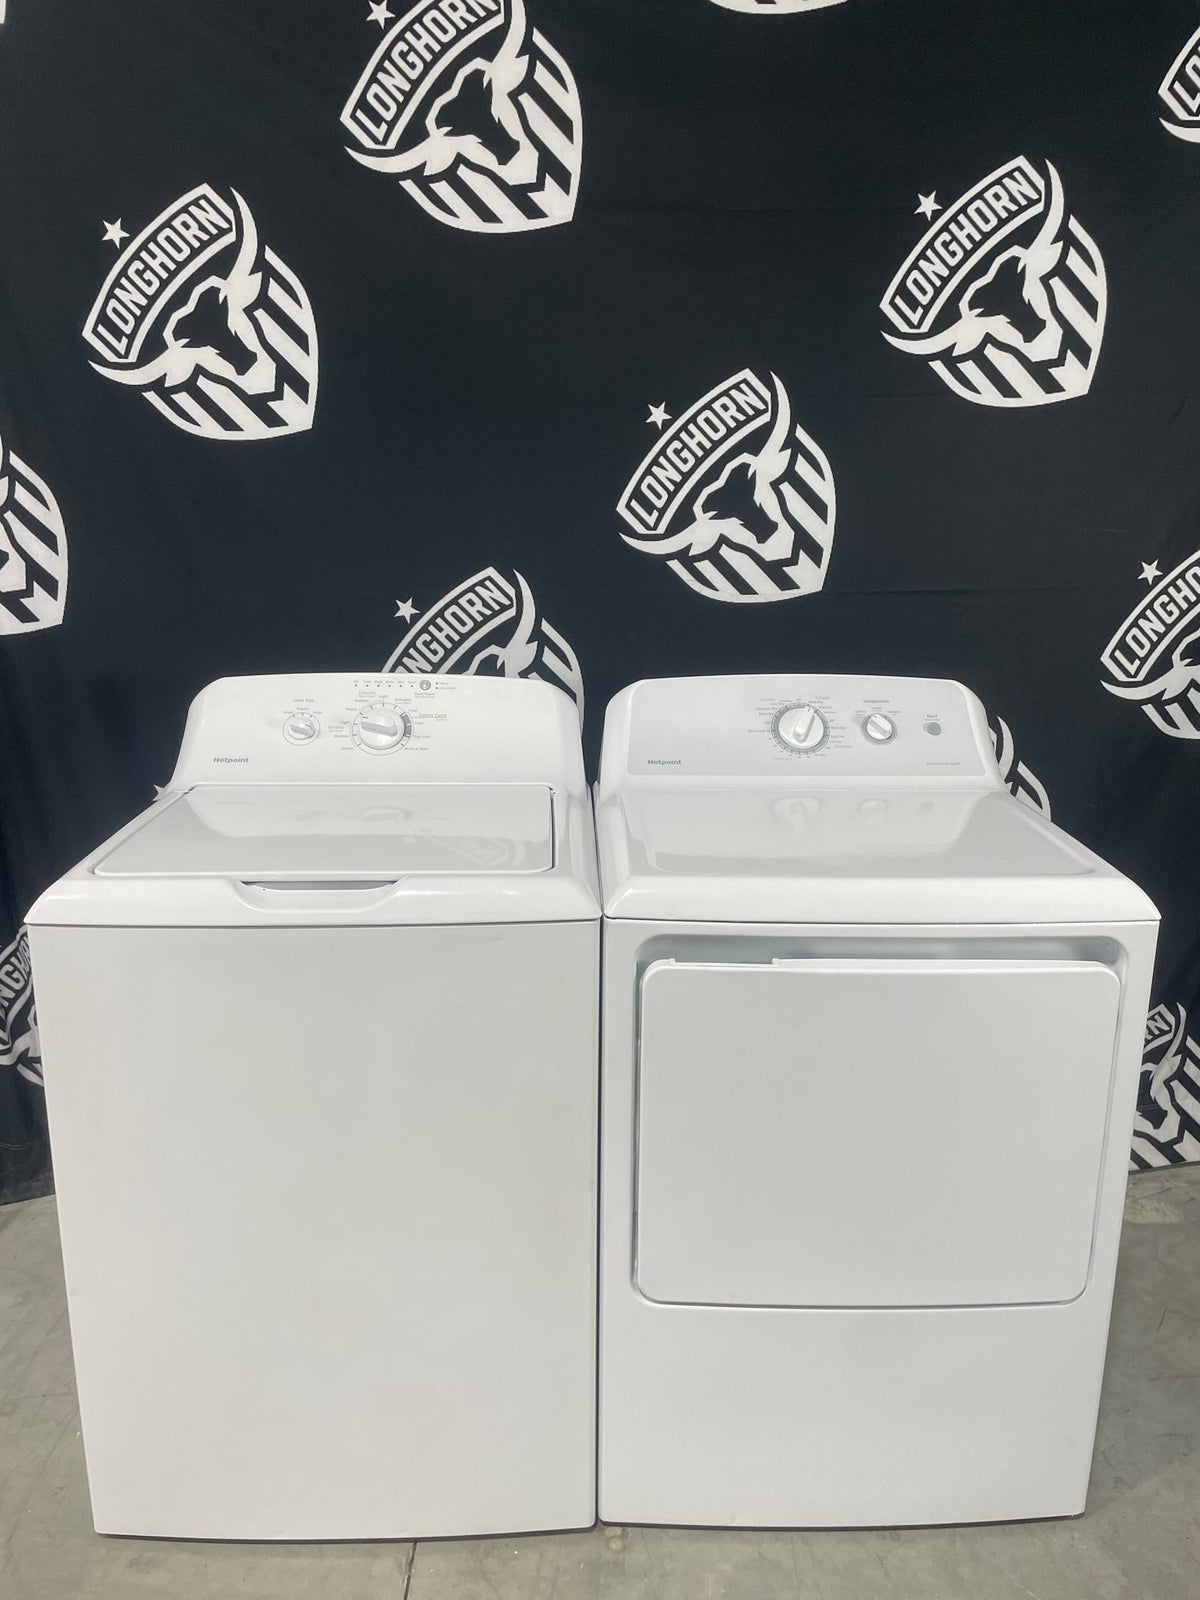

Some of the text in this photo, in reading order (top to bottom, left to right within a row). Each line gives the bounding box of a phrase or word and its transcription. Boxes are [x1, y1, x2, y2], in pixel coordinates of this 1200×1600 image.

[96, 199, 231, 356] LONGHORN
[889, 171, 1040, 326] LONGHORN
[629, 383, 767, 528] LONGHORN
[394, 580, 512, 674] NGHORN
[1113, 566, 1200, 676] LONGHO
